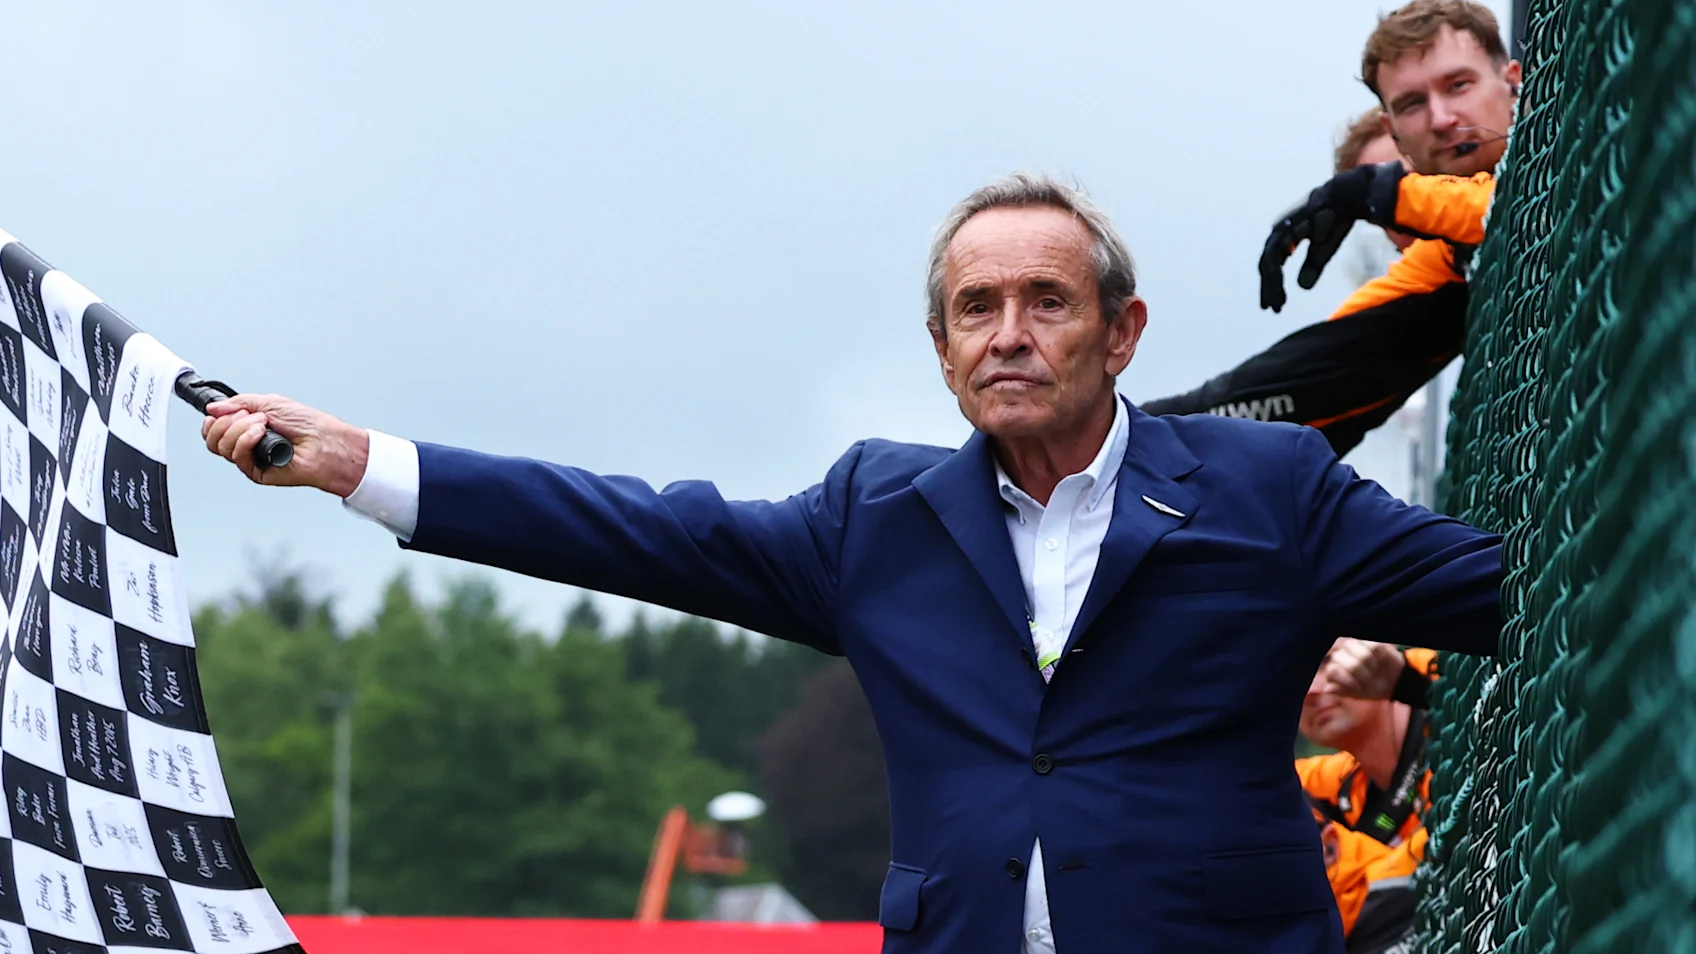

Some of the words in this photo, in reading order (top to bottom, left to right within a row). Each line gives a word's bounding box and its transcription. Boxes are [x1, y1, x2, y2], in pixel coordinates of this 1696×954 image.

[110, 468, 122, 503] Julia
[140, 469, 151, 502] Dad
[148, 560, 164, 623] Hopkinson
[66, 622, 83, 675] Richard
[138, 640, 164, 715] Graham
[162, 665, 185, 707] Knox
[70, 711, 86, 768] Jonathan
[86, 709, 100, 756] Heather
[109, 757, 126, 783] Aug
[16, 785, 29, 817] Riley
[46, 780, 60, 819] Ferrari
[35, 872, 52, 911] Emily
[103, 883, 137, 932] Robert
[139, 883, 171, 940] Barney
[205, 911, 231, 943] Werner
